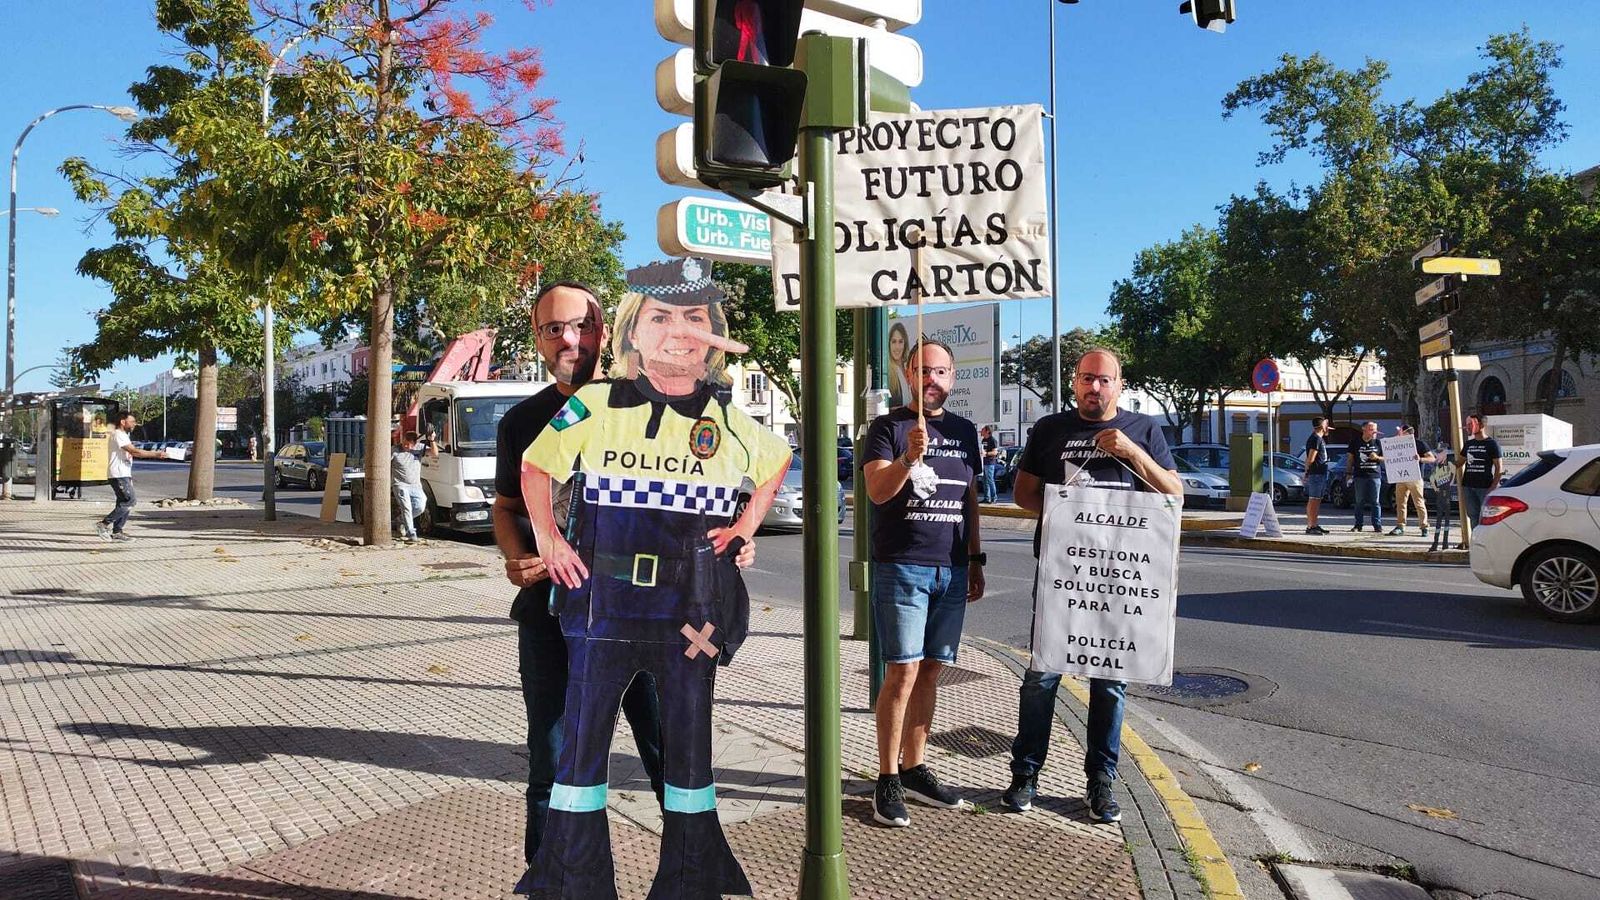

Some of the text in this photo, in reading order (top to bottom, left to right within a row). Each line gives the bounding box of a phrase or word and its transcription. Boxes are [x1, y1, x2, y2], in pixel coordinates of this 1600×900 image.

[837, 117, 1016, 154] PROYECTO
[861, 159, 1023, 200] FUTURO
[696, 207, 733, 227] Urb.
[696, 226, 734, 246] Urb.
[835, 208, 1008, 253] OLICÍAS
[871, 255, 1043, 300] CARTÓN
[973, 367, 989, 378] 038
[949, 388, 971, 397] OMPRA
[948, 400, 968, 408] VENTA
[603, 450, 704, 476] POLICÍA
[1397, 469, 1409, 478] YA
[904, 512, 964, 523] MENTIROSO
[1074, 512, 1149, 528] ALCALDE
[1067, 546, 1151, 564] GESTIONA
[1073, 565, 1142, 581] Y BUSCA
[1054, 579, 1160, 599] SOLUCIONES
[1068, 599, 1143, 616] PARA LA
[1067, 635, 1137, 652] POLICÍA
[1066, 653, 1124, 670] LOCAL
